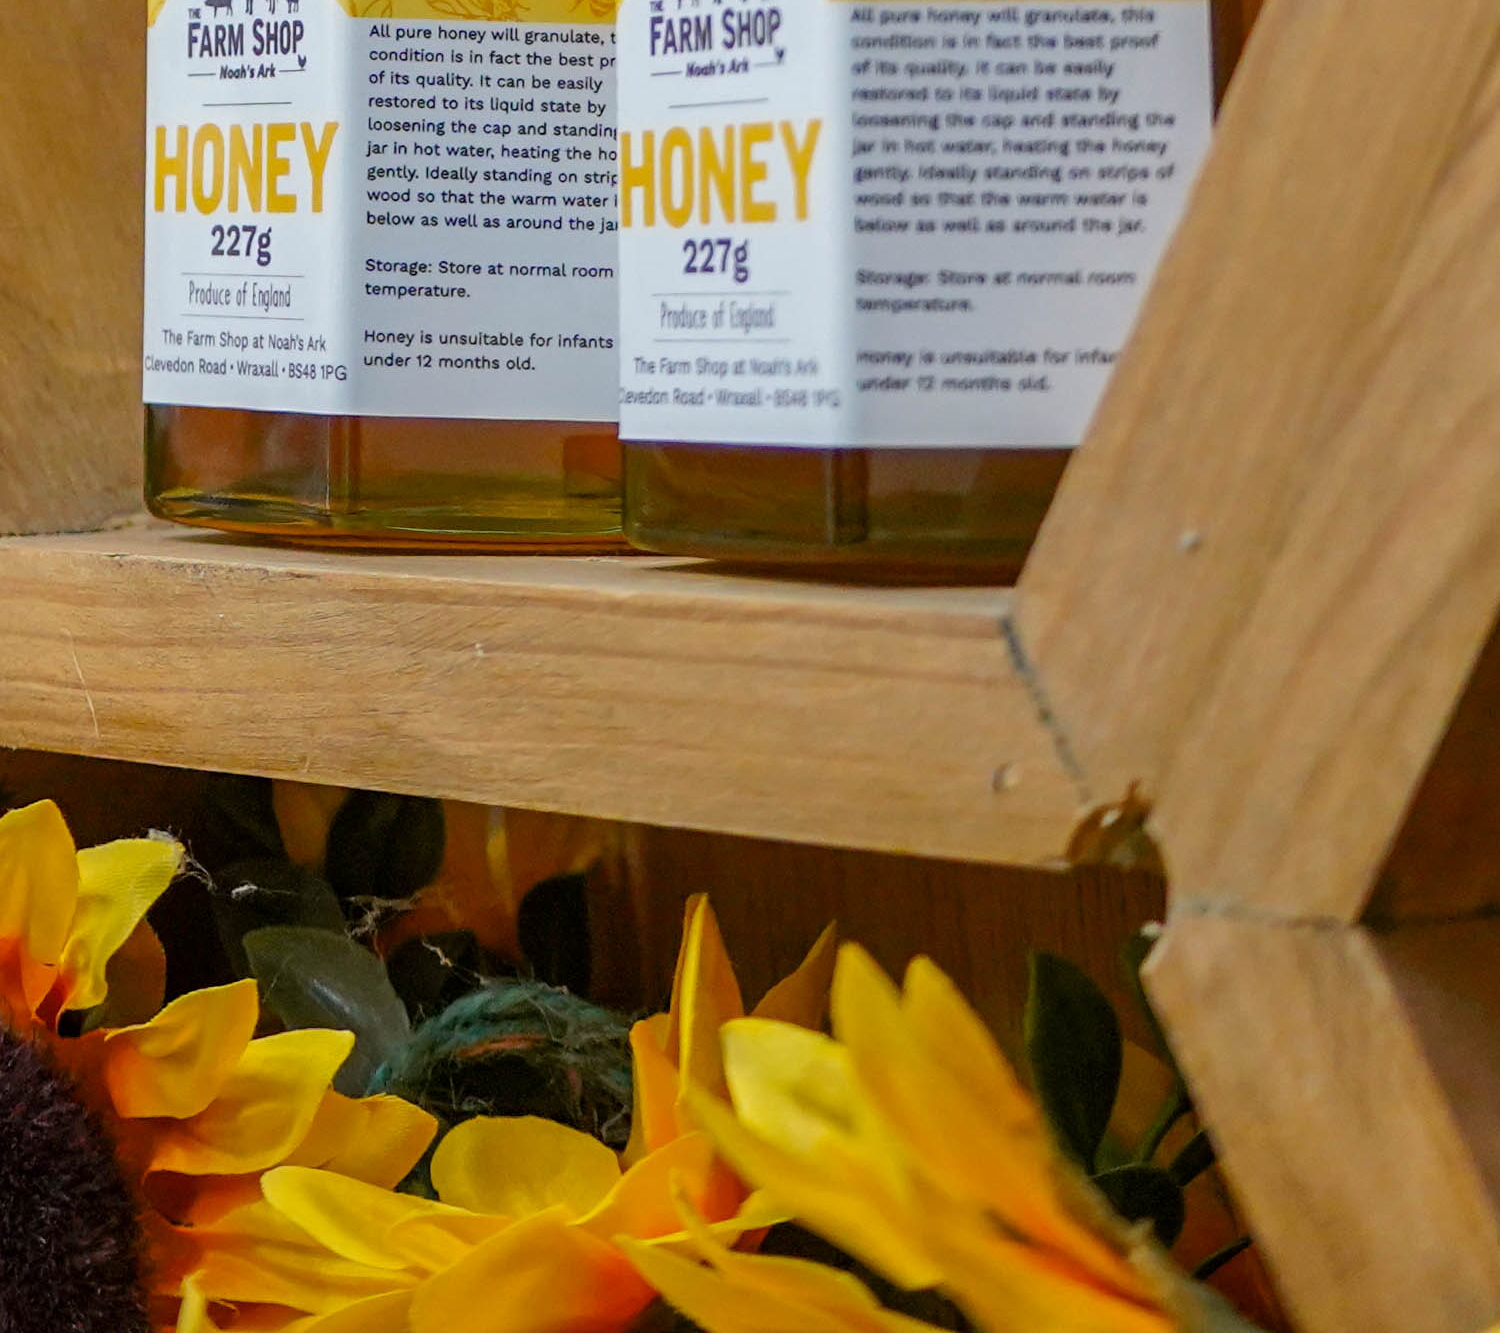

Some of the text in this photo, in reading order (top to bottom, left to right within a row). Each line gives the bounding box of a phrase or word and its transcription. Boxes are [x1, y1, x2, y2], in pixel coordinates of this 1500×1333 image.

[188, 19, 304, 58] FARM SHOP
[650, 8, 781, 56] FARM SHOP
[219, 64, 275, 79] Noah's Ark
[686, 59, 749, 78] Noah's Ark
[153, 121, 340, 215] HONEY
[620, 119, 822, 228] HONEY
[211, 224, 272, 266] 227g
[683, 238, 750, 282] 227g
[189, 281, 291, 312] Produce of England
[162, 330, 326, 351] The Farm Shop at Noah's Ark
[145, 356, 347, 380] Clevedon Road Wraxall BS48 1PG
